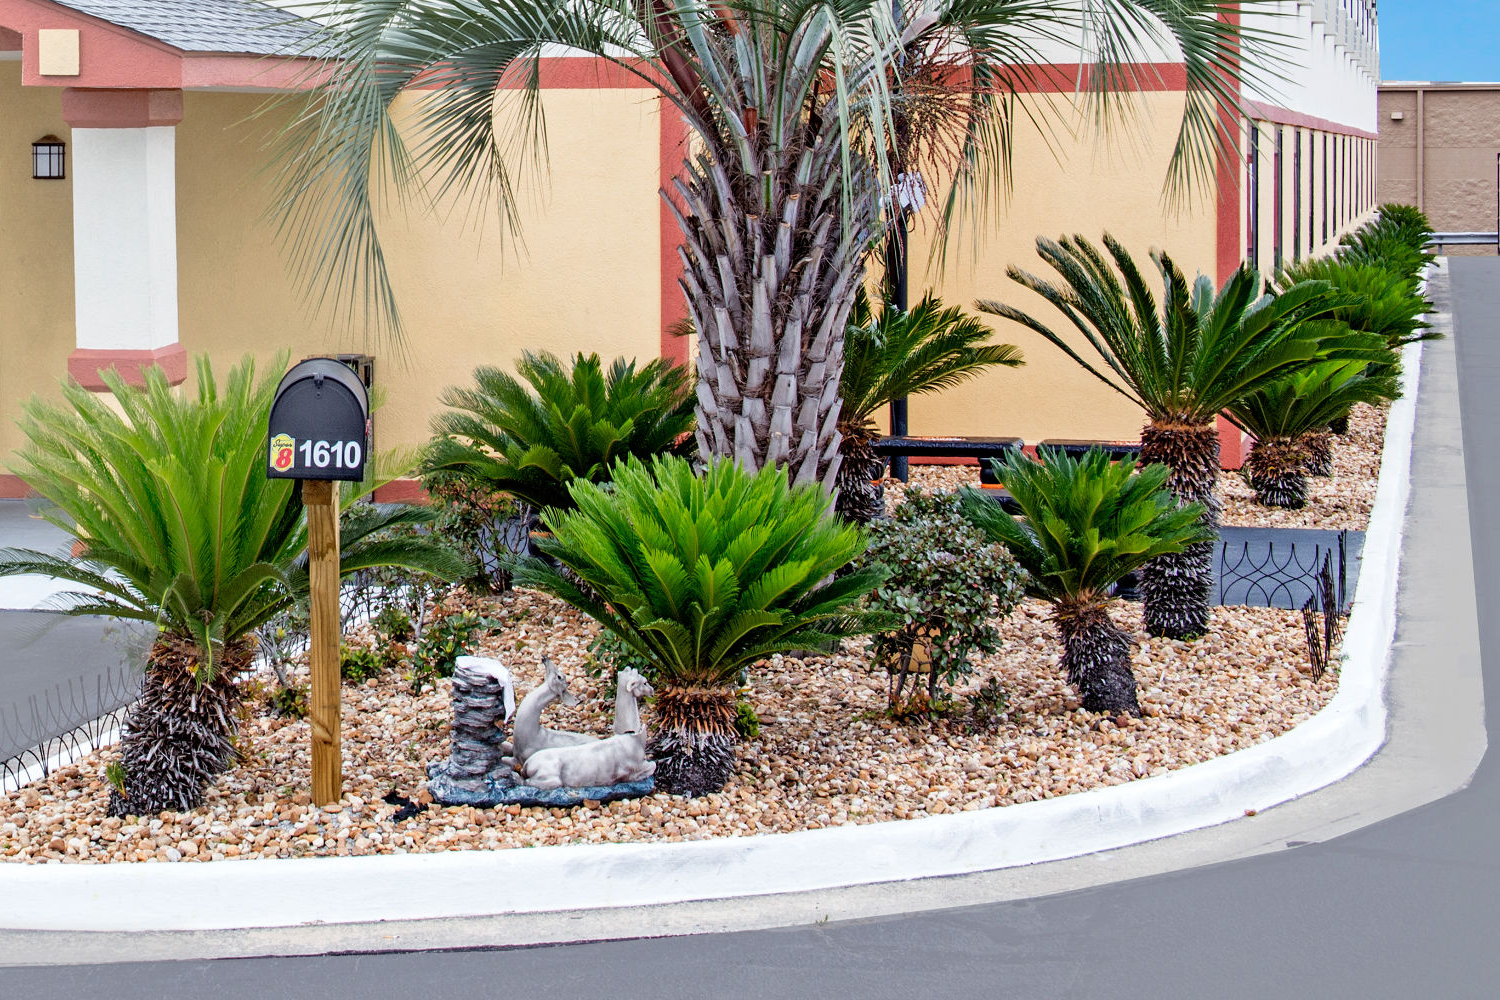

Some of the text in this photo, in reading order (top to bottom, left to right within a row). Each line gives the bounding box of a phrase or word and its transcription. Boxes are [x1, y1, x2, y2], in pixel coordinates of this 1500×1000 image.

[273, 439, 292, 451] Super
[299, 440, 361, 469] 1610
[276, 448, 292, 468] 8
